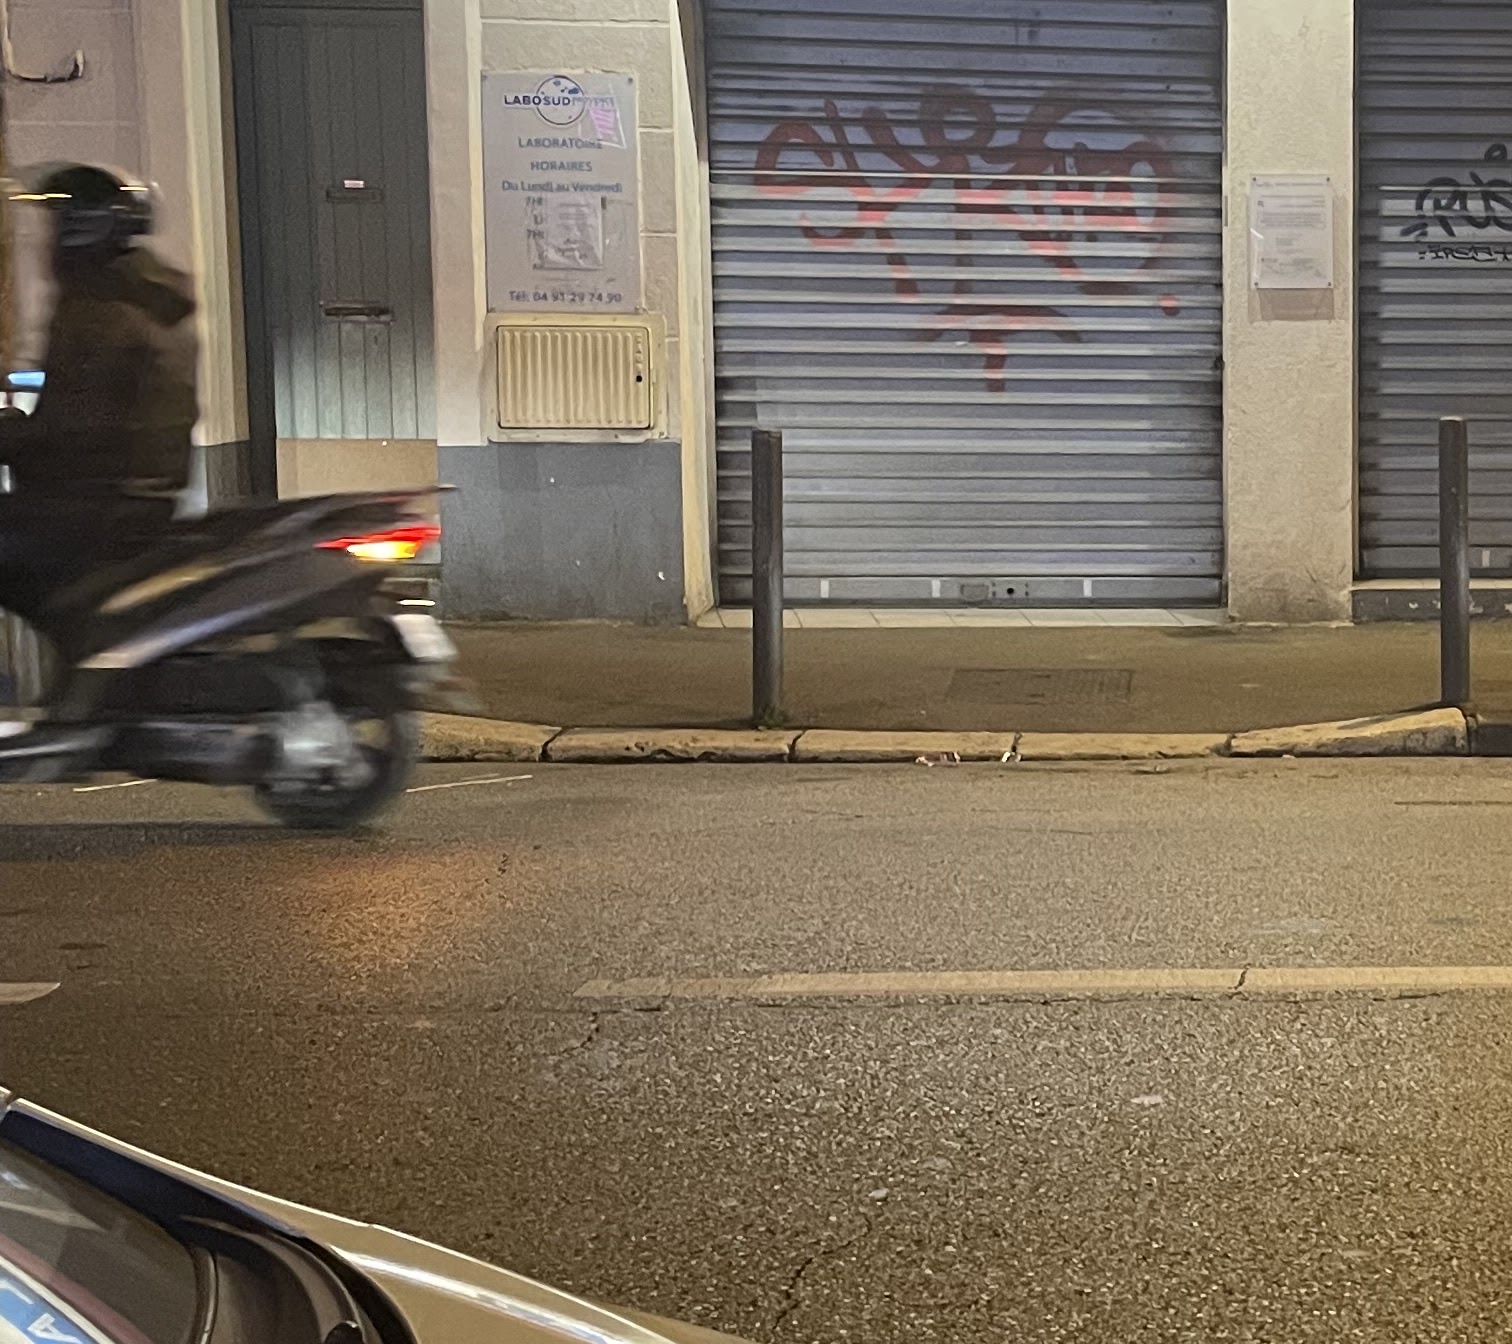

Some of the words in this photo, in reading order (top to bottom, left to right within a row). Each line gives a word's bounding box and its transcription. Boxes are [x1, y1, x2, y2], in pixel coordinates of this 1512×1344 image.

[503, 95, 571, 106] LABOSUD
[530, 161, 593, 172] HORAIRES
[501, 180, 519, 191] Du
